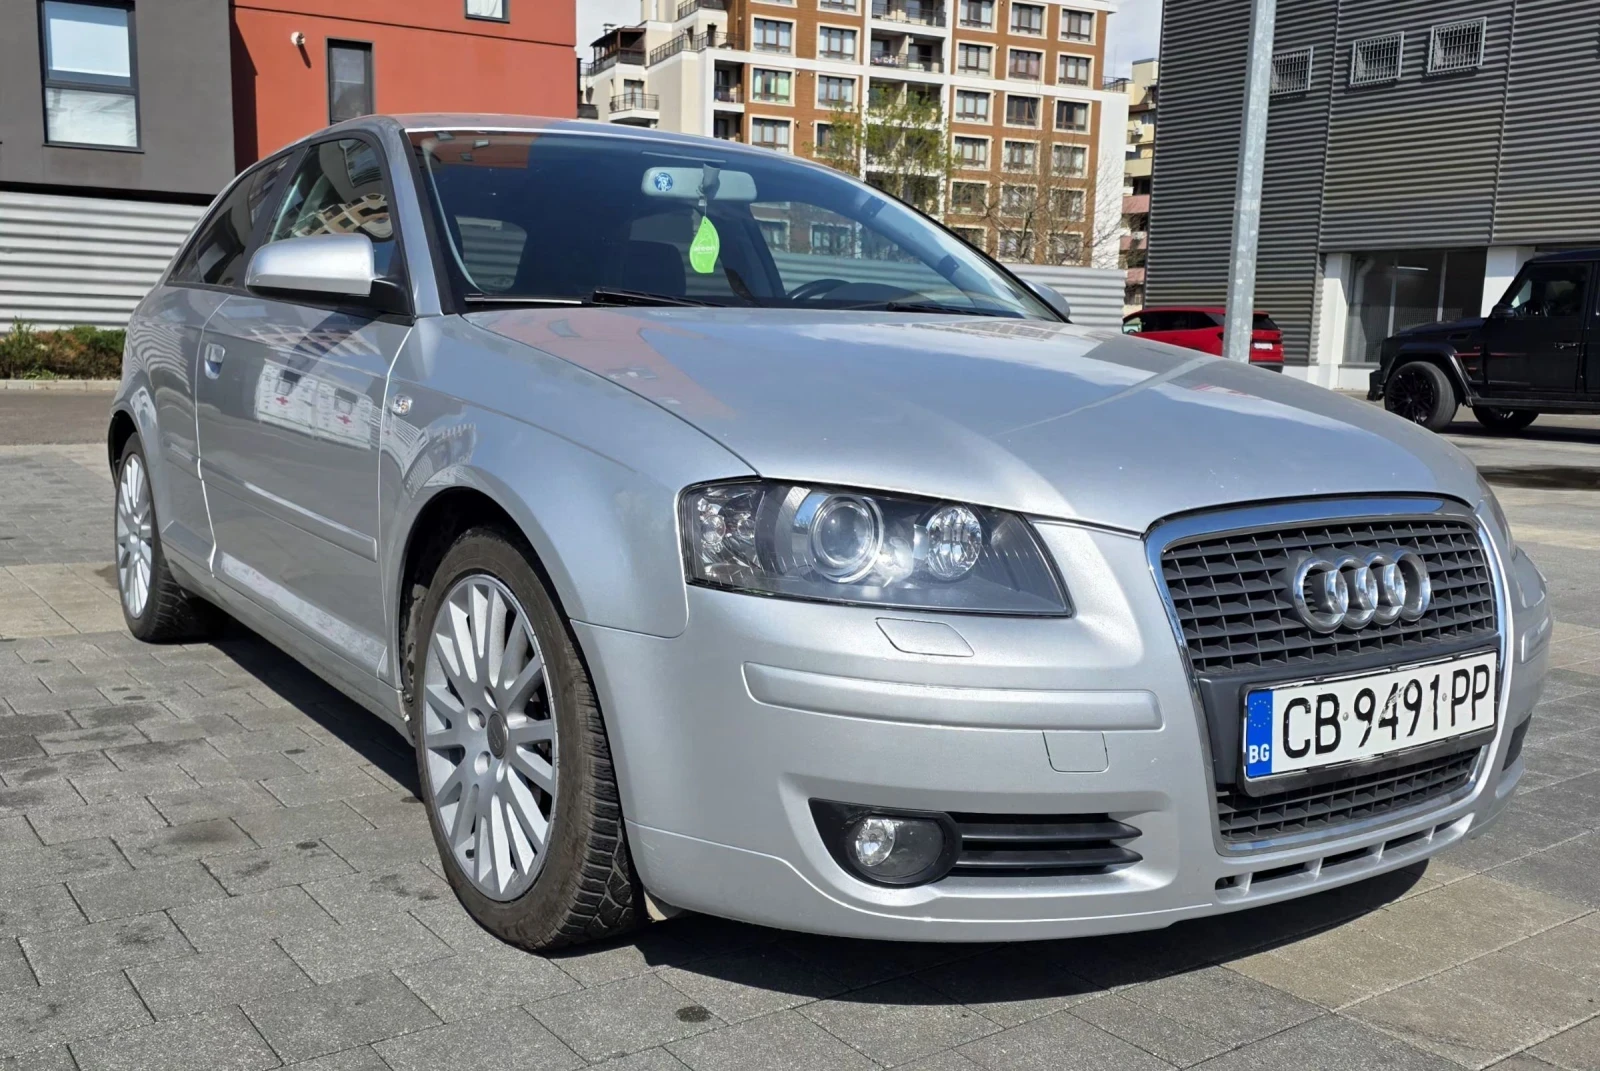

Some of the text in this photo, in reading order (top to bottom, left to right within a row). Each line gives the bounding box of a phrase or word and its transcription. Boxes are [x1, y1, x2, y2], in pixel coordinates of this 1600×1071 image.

[1283, 693, 1341, 759] CB
[1451, 664, 1490, 727] PP
[1248, 743, 1270, 764] BG
